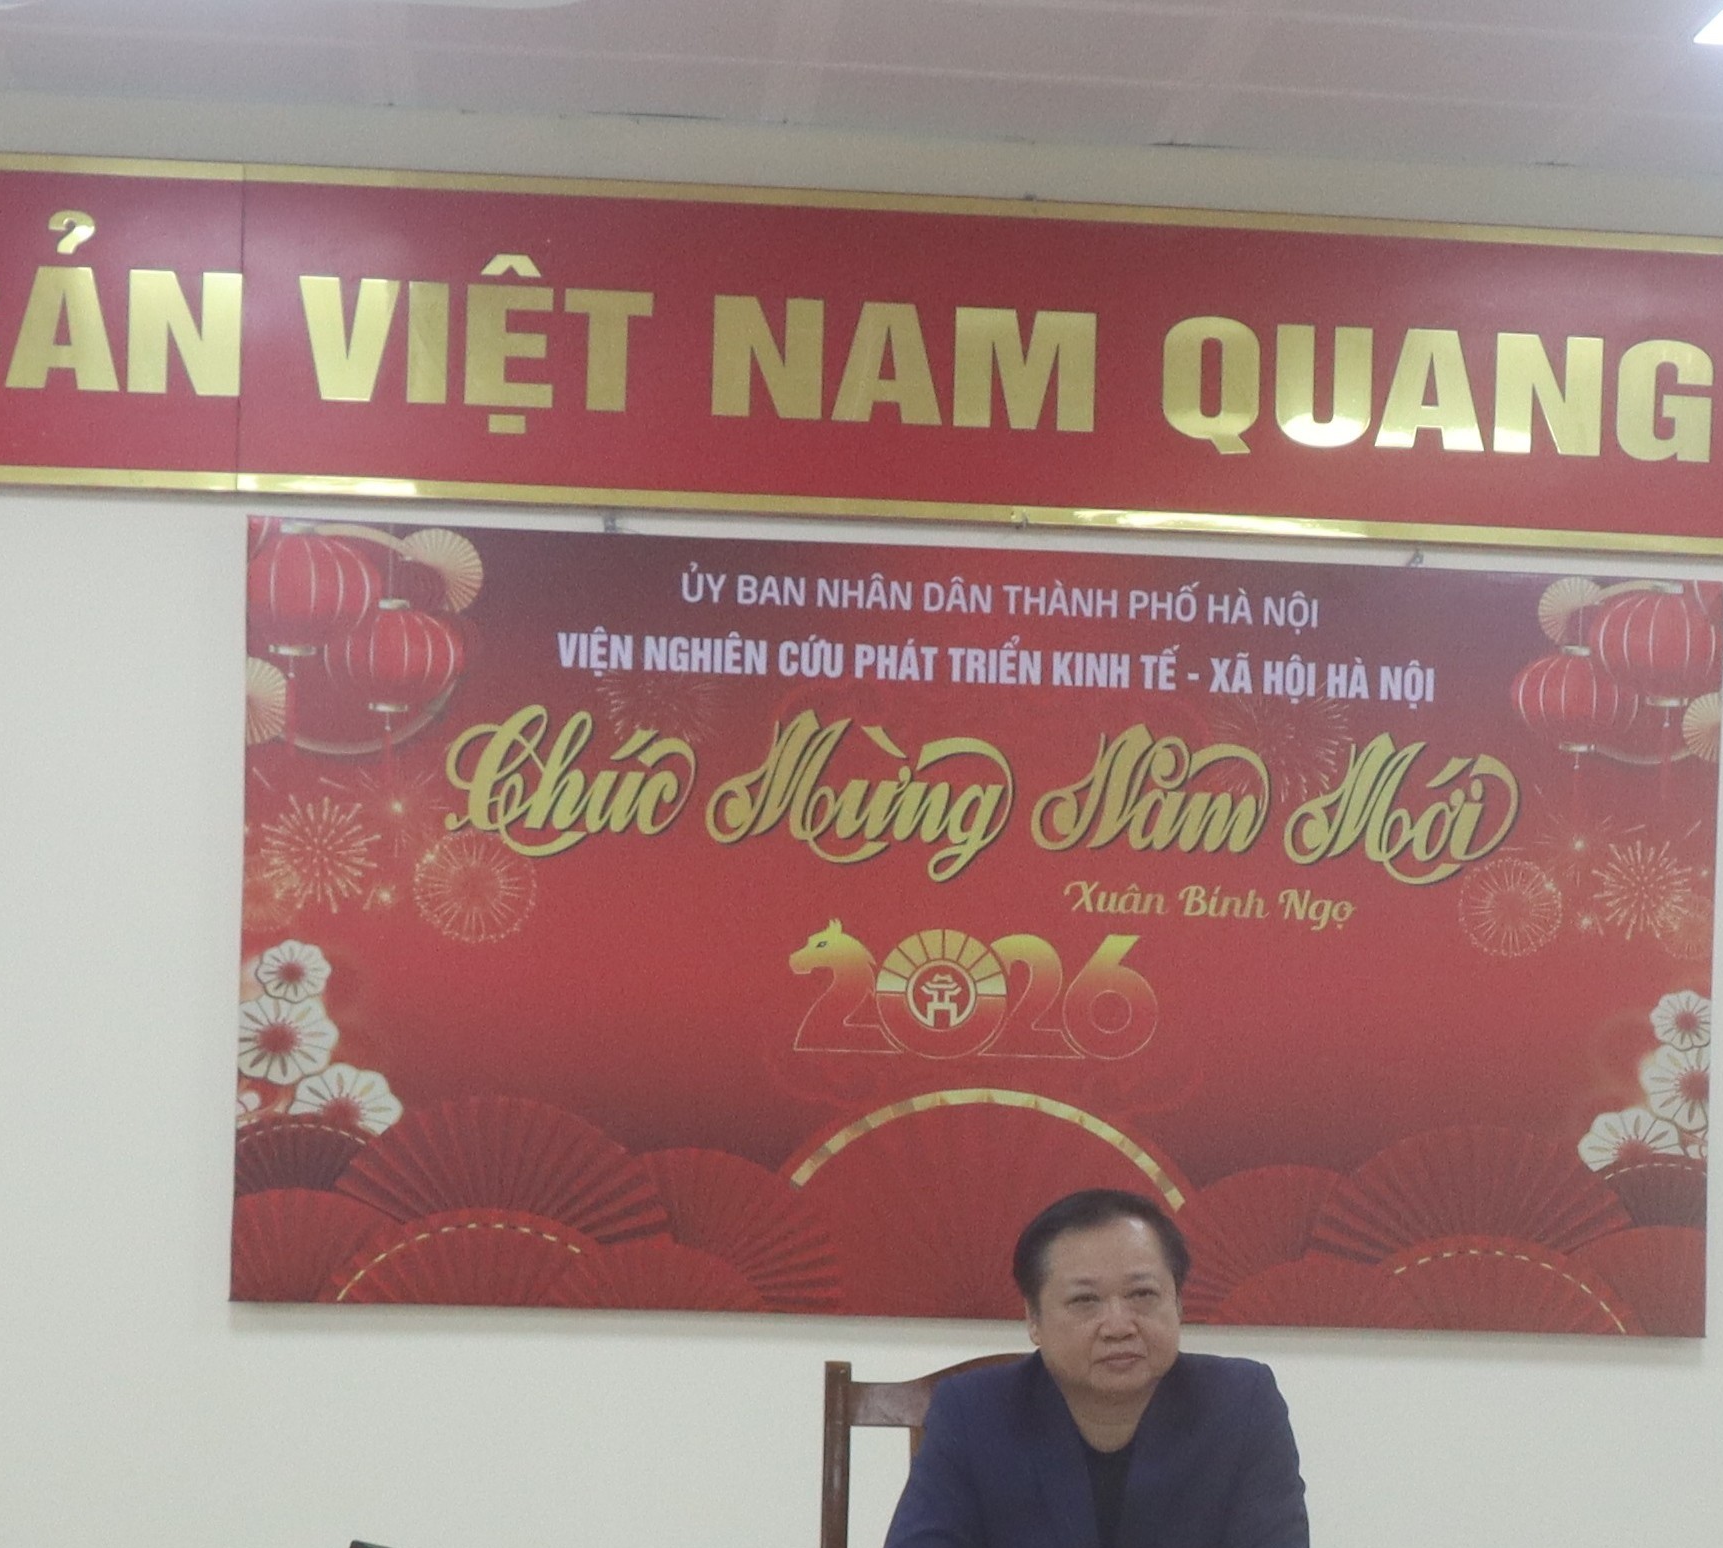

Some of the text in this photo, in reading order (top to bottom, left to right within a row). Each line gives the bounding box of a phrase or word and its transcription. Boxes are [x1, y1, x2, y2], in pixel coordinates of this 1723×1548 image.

[302, 253, 653, 435] VIỆT
[711, 295, 1097, 433] NAM
[1161, 315, 1712, 466] QUANG
[681, 562, 1319, 635] ỦY BAN NHÂN DÂN THÀNH PHỐ HÀ NỘI
[557, 625, 634, 677] VIỆN
[643, 631, 768, 675] NGHIÊN
[778, 634, 844, 678] CỨU
[854, 638, 939, 682] PHÁT
[947, 635, 1042, 686] TRIỂN
[1052, 651, 1130, 689] KINH
[1139, 645, 1180, 691] TẾ
[1209, 652, 1253, 695] XÃ
[1262, 653, 1317, 705] HỘI
[1325, 656, 1370, 700] HÀ
[1378, 659, 1436, 710] NỘI
[444, 704, 698, 857] Chúc
[705, 709, 1014, 882] Mừng
[1283, 732, 1520, 885] Mới
[1064, 881, 1357, 932] Xuân Bính Ngọ
[788, 918, 1160, 1060] 2026
